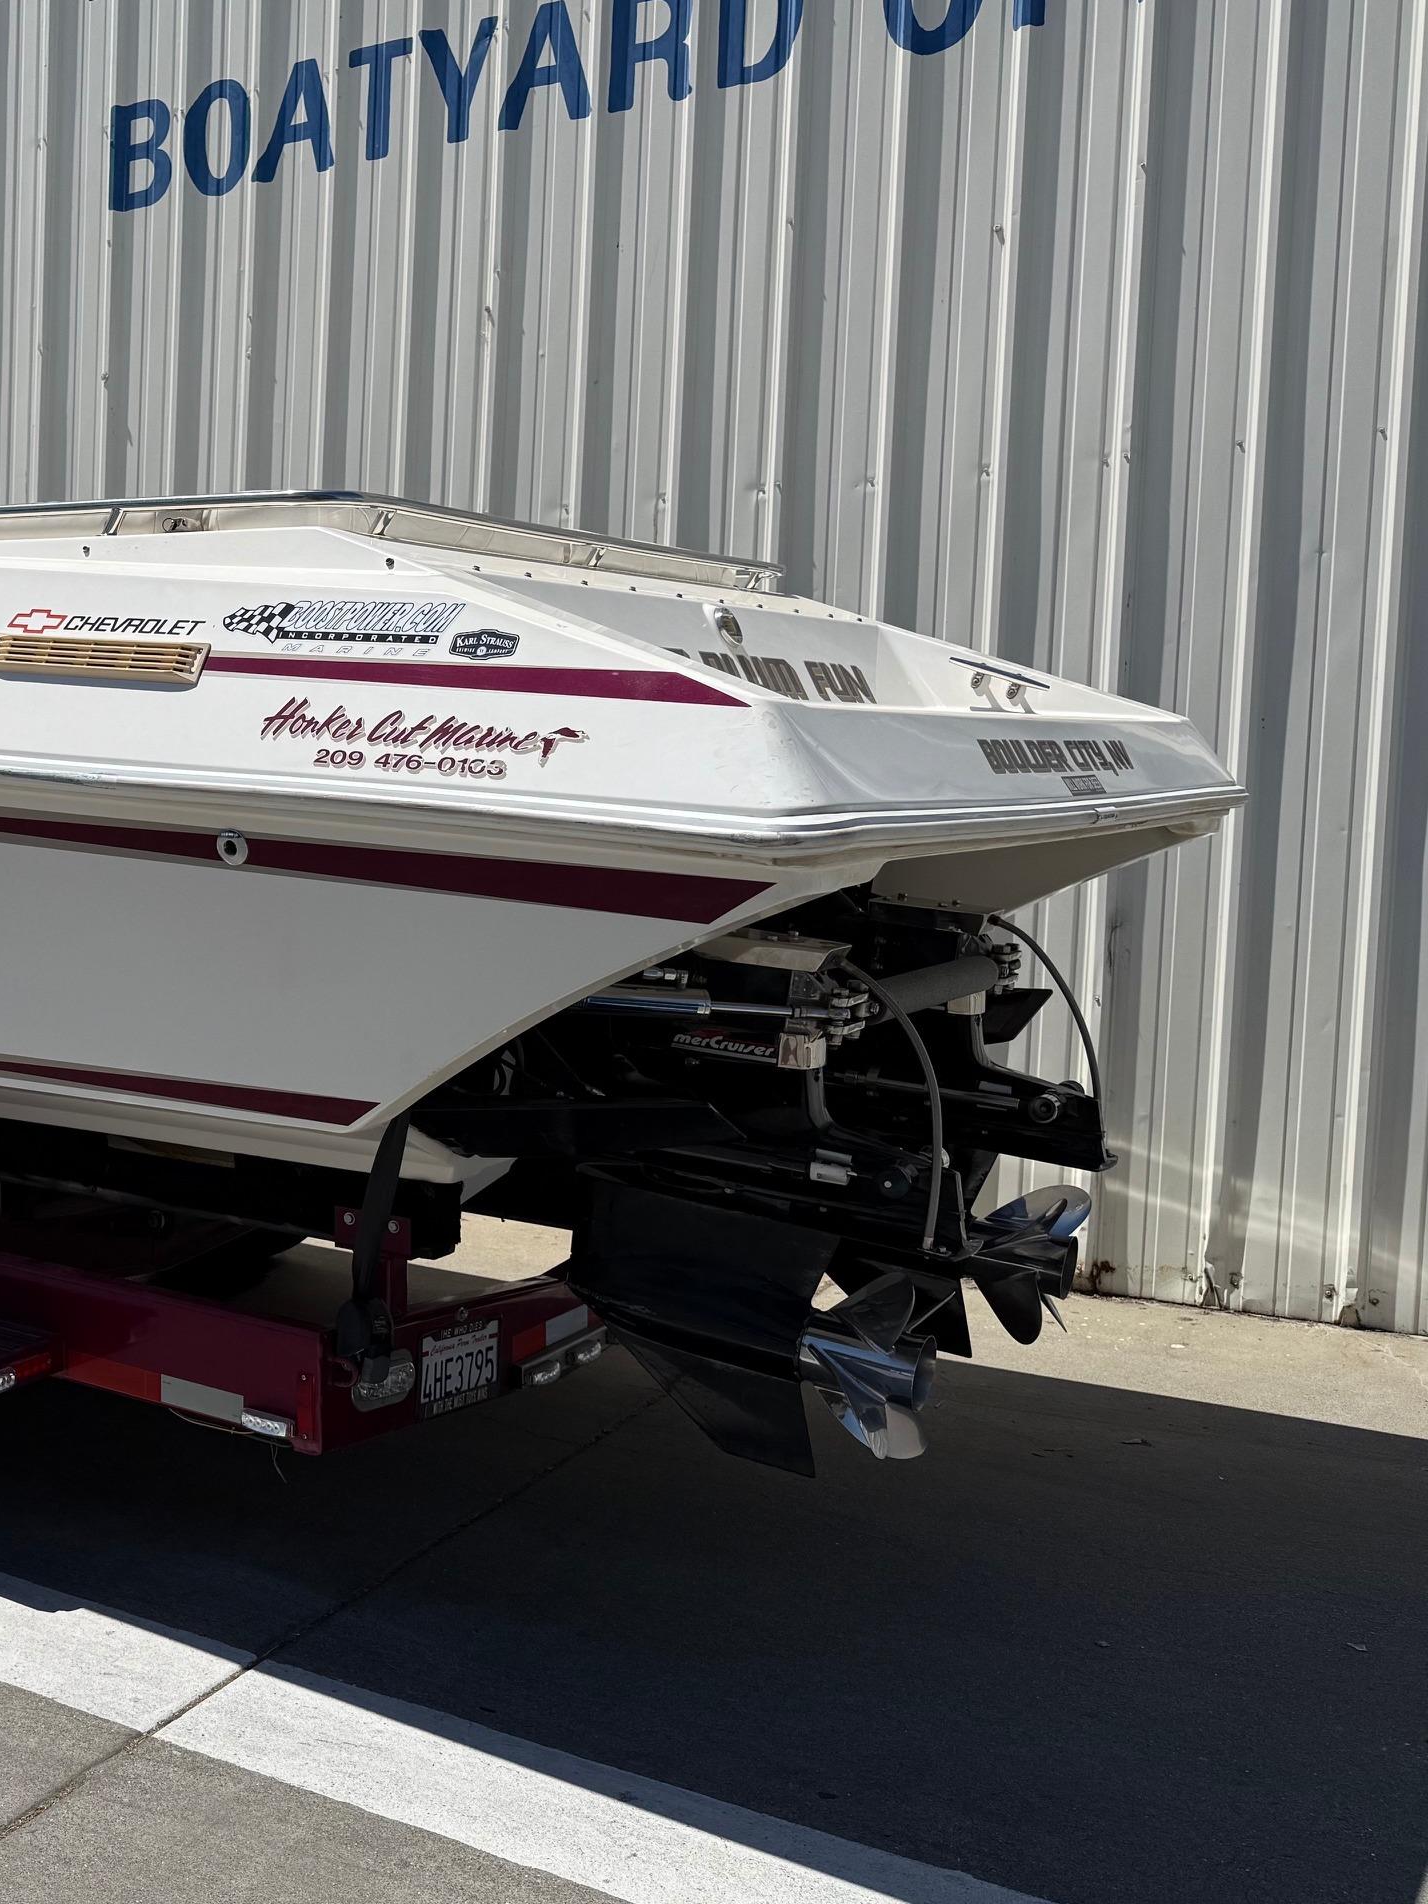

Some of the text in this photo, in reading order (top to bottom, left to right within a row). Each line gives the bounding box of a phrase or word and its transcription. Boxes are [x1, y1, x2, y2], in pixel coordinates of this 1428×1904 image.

[109, 0, 804, 212] BOATYARD
[63, 615, 206, 636] CHEVROLET
[283, 600, 466, 633] BOOSTPOWER.COM
[279, 631, 439, 644] INCORPORATED
[281, 643, 430, 657] MARINE
[456, 633, 514, 649] KARL STRAUSS
[803, 660, 877, 704] FUN
[260, 696, 538, 751] Honker Cut Marine
[313, 748, 364, 766] 209
[976, 738, 1075, 775] BOULDER
[1102, 740, 1135, 769] NV
[673, 1033, 776, 1056] merCruiser
[422, 1346, 494, 1402] 4HE3795
